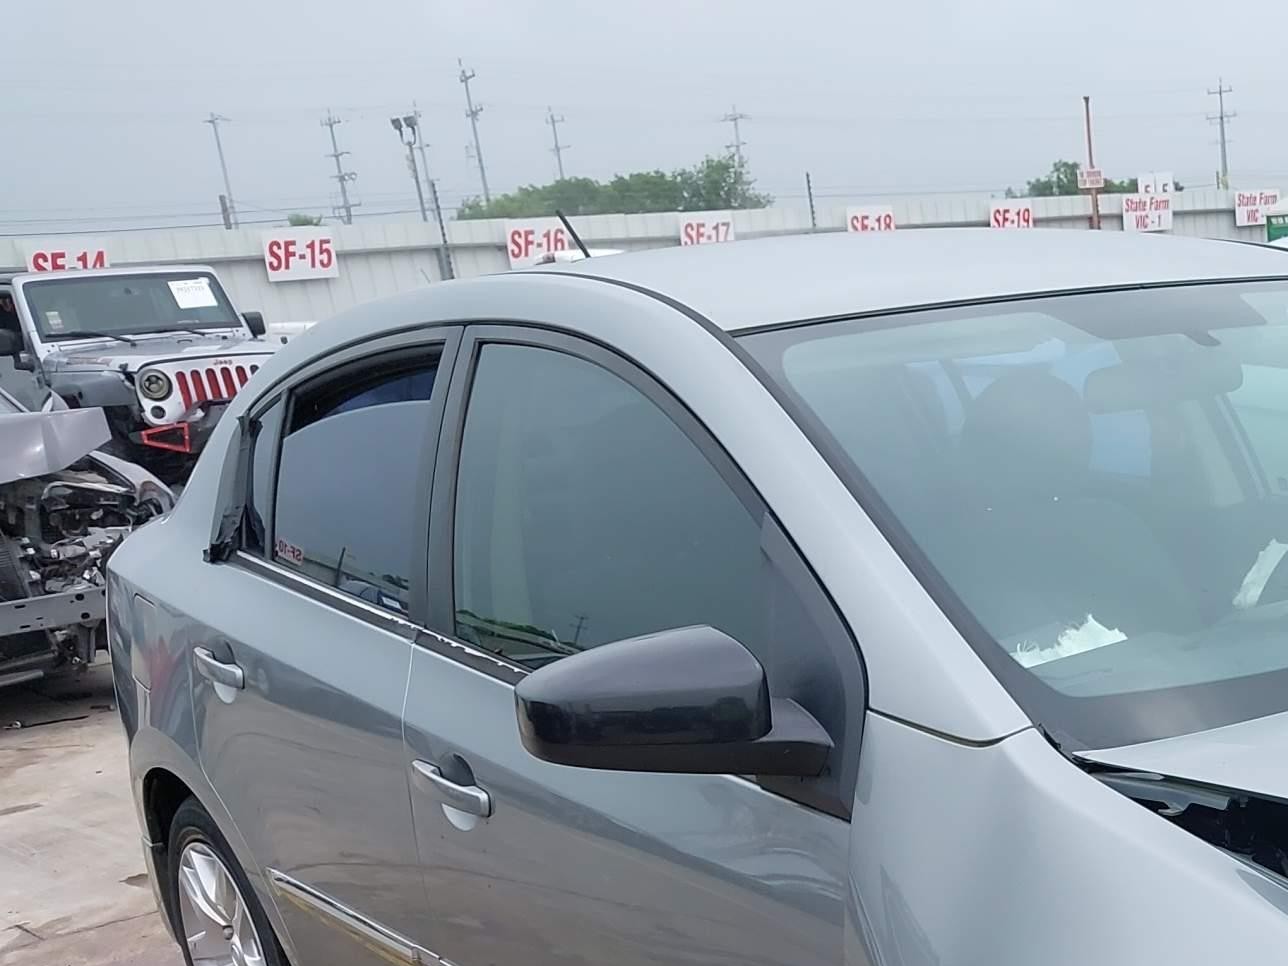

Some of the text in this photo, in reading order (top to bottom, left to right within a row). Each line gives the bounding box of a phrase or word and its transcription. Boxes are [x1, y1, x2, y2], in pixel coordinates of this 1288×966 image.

[1124, 196, 1170, 213] State Farm
[1237, 192, 1278, 208] State Farm
[993, 207, 1031, 228] SF-19
[1135, 214, 1149, 229] VIC
[510, 228, 565, 259] SF-16
[684, 221, 731, 246] SF-17
[32, 251, 105, 271] SF14
[267, 238, 333, 272] SF-15
